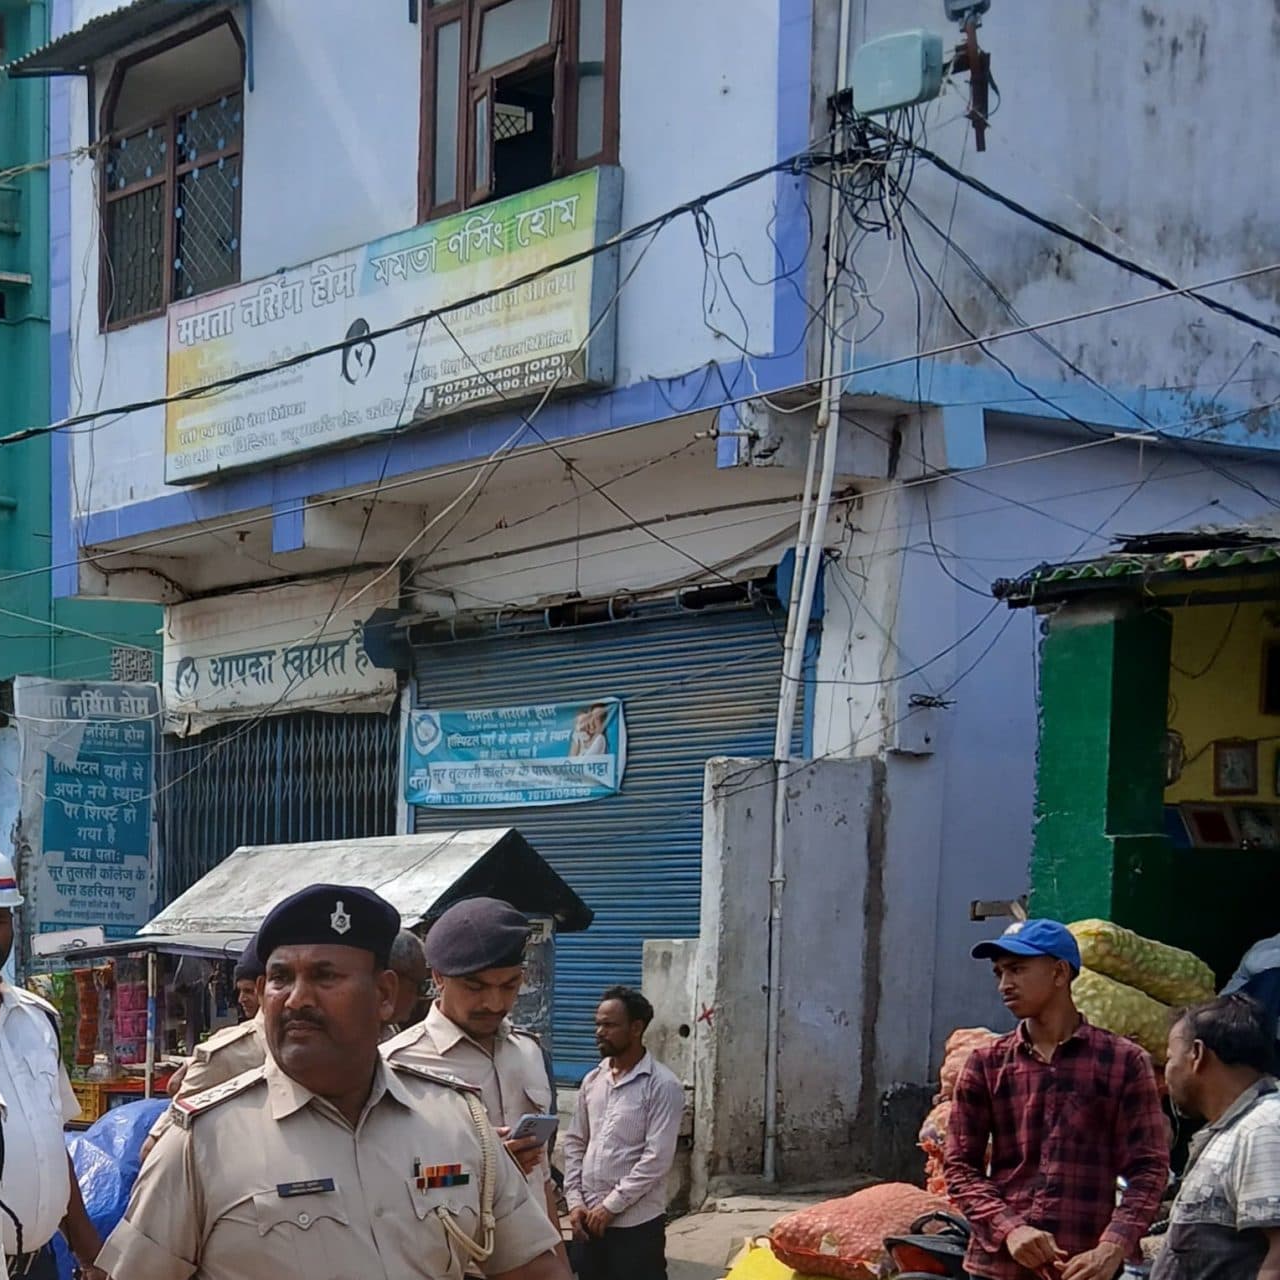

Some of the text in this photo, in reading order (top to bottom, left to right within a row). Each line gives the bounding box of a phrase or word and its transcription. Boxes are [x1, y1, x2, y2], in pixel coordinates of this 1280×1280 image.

[516, 194, 580, 247] হোম
[176, 303, 236, 346] ममता
[310, 263, 357, 308] होम
[208, 649, 276, 689] आपका
[281, 639, 350, 684] स्वागत
[119, 690, 148, 715] होम
[123, 724, 145, 742] होम
[132, 762, 144, 782] से
[54, 778, 83, 797] अपने
[63, 803, 80, 819] पर
[123, 803, 137, 824] हो
[77, 823, 117, 845] गया है
[71, 847, 92, 860] नया
[56, 883, 78, 897] पास
